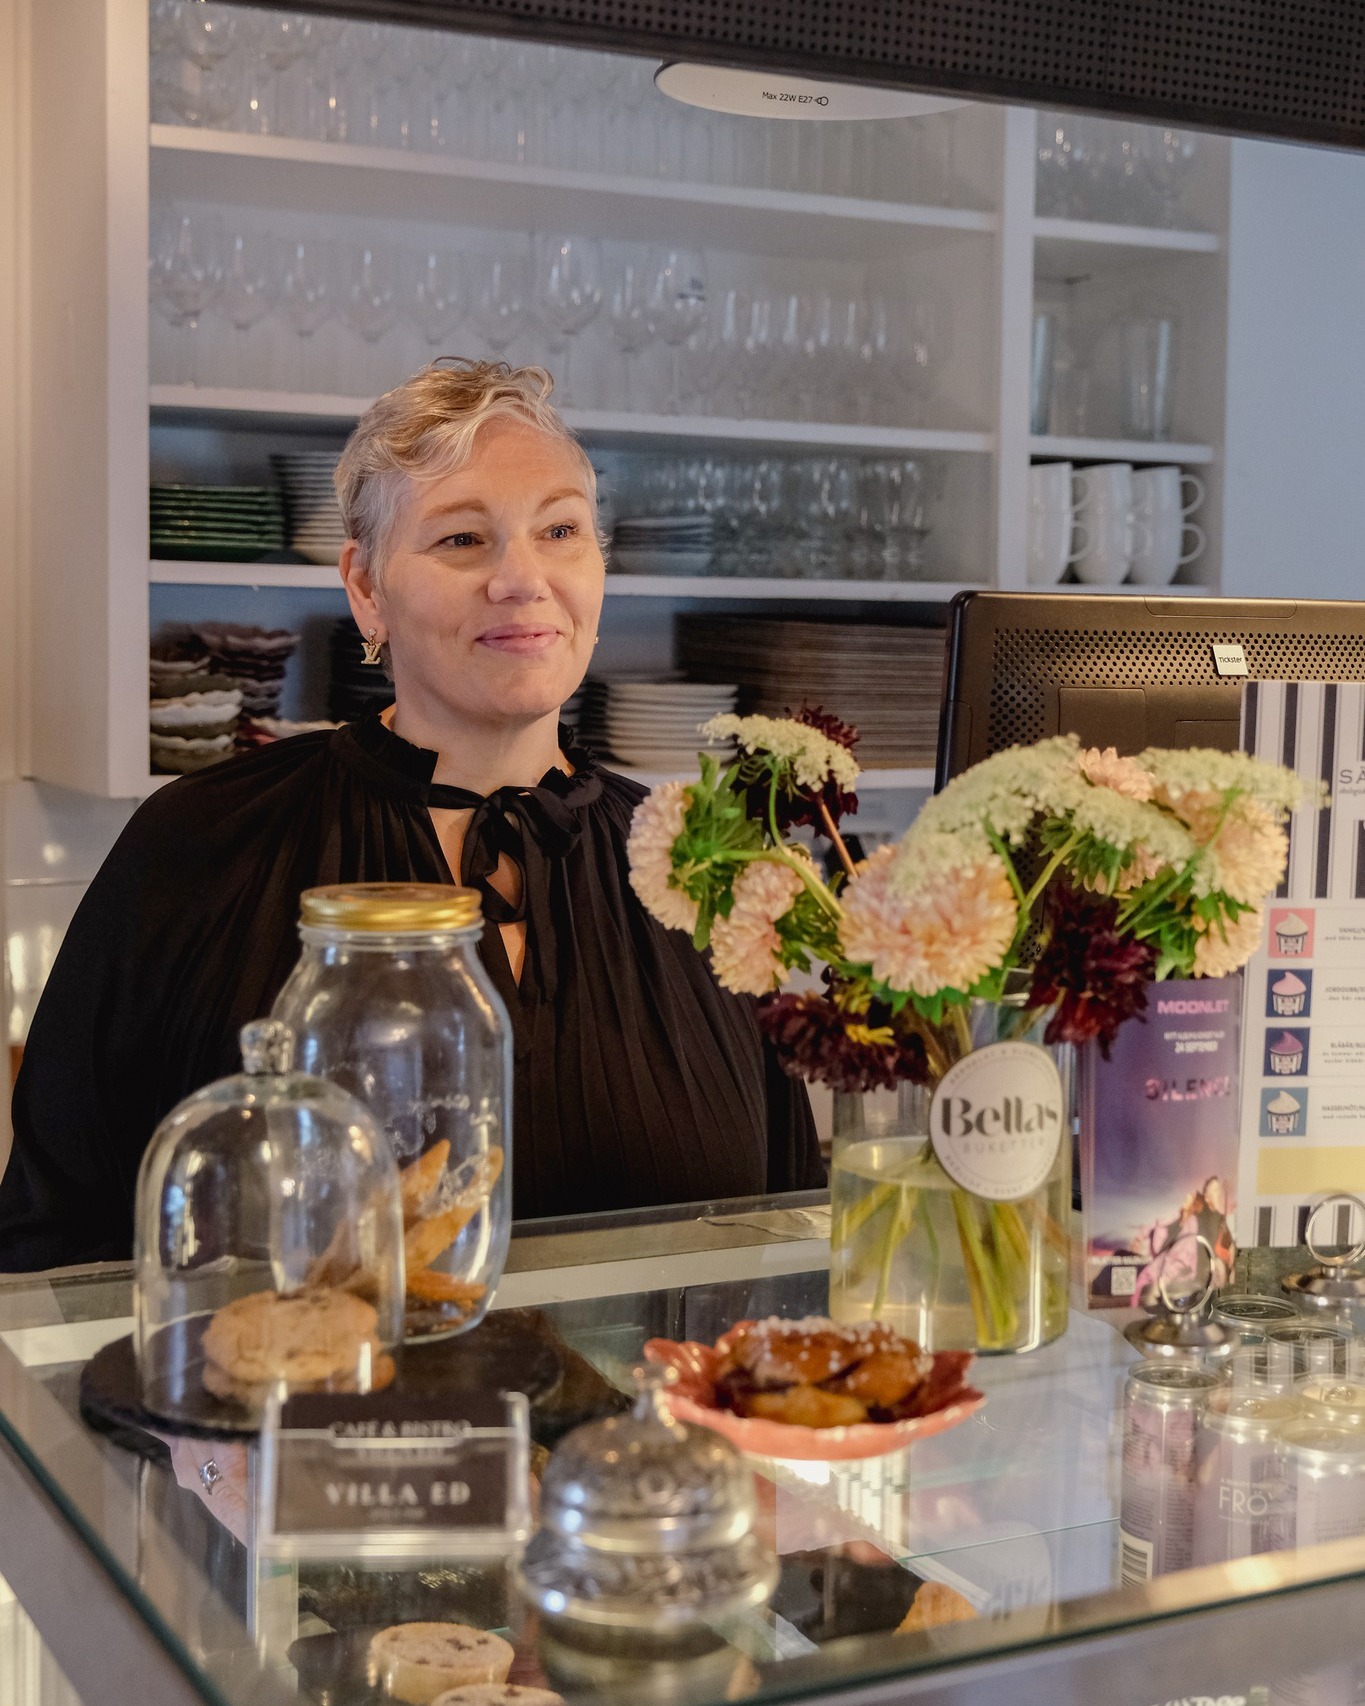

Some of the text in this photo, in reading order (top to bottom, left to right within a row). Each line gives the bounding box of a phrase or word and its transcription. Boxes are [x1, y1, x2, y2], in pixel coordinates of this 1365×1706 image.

[762, 91, 813, 104] Max 22W E27
[1218, 656, 1242, 664] Tickster
[941, 1095, 1058, 1138] Bellas
